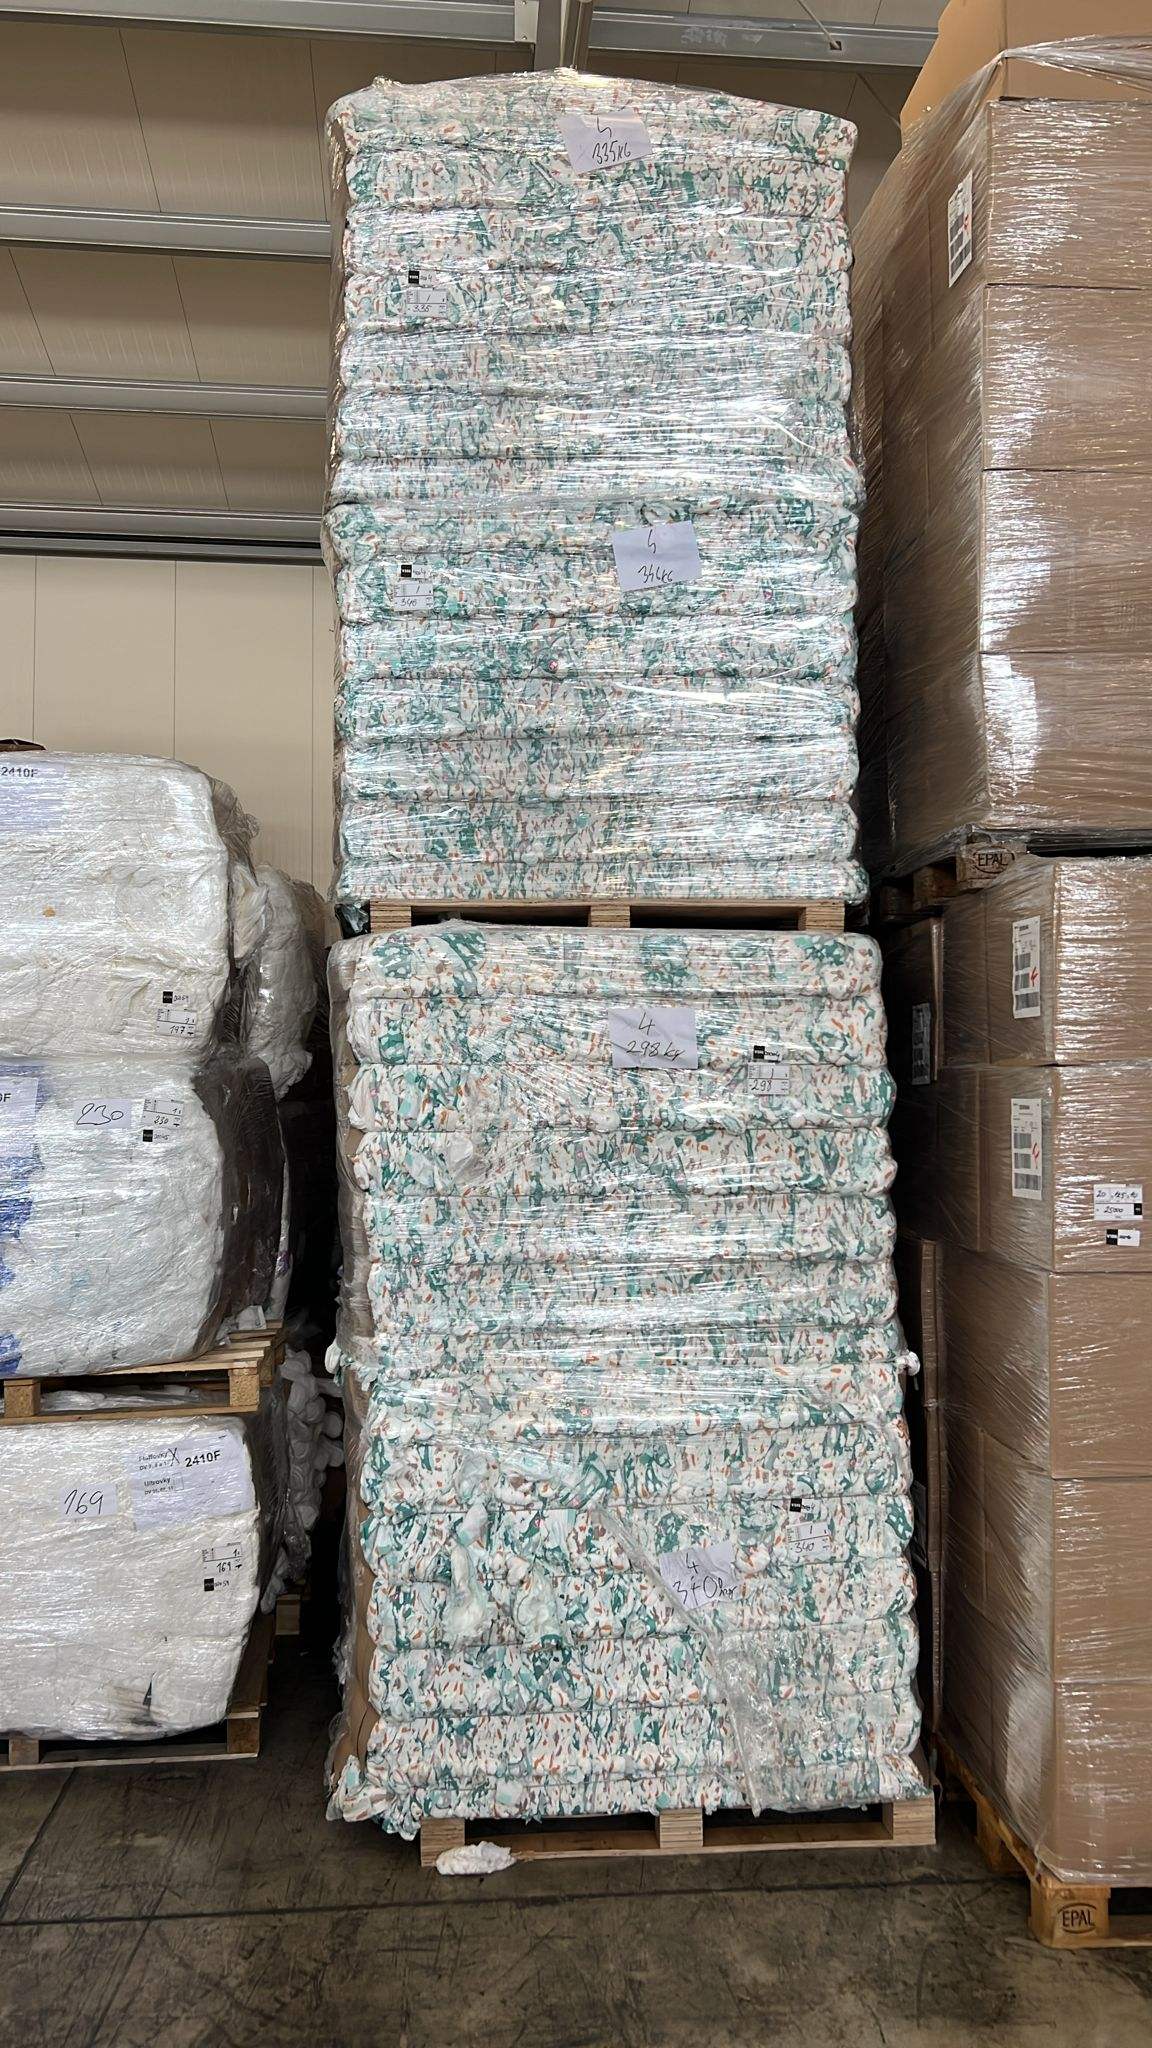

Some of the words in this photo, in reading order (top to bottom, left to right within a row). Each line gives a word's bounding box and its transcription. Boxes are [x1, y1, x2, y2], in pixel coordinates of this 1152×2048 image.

[1, 766, 39, 778] 2410F
[977, 853, 1009, 867] EPAL
[169, 1025, 186, 1035] 197
[638, 1011, 656, 1036] 4
[750, 1079, 773, 1092] 298
[75, 1102, 125, 1126] 230
[153, 1114, 169, 1126] 230
[184, 1449, 222, 1468] 2410F
[64, 1489, 104, 1515] 169
[685, 1552, 701, 1574] 4
[1061, 1909, 1096, 1927] EPAL
